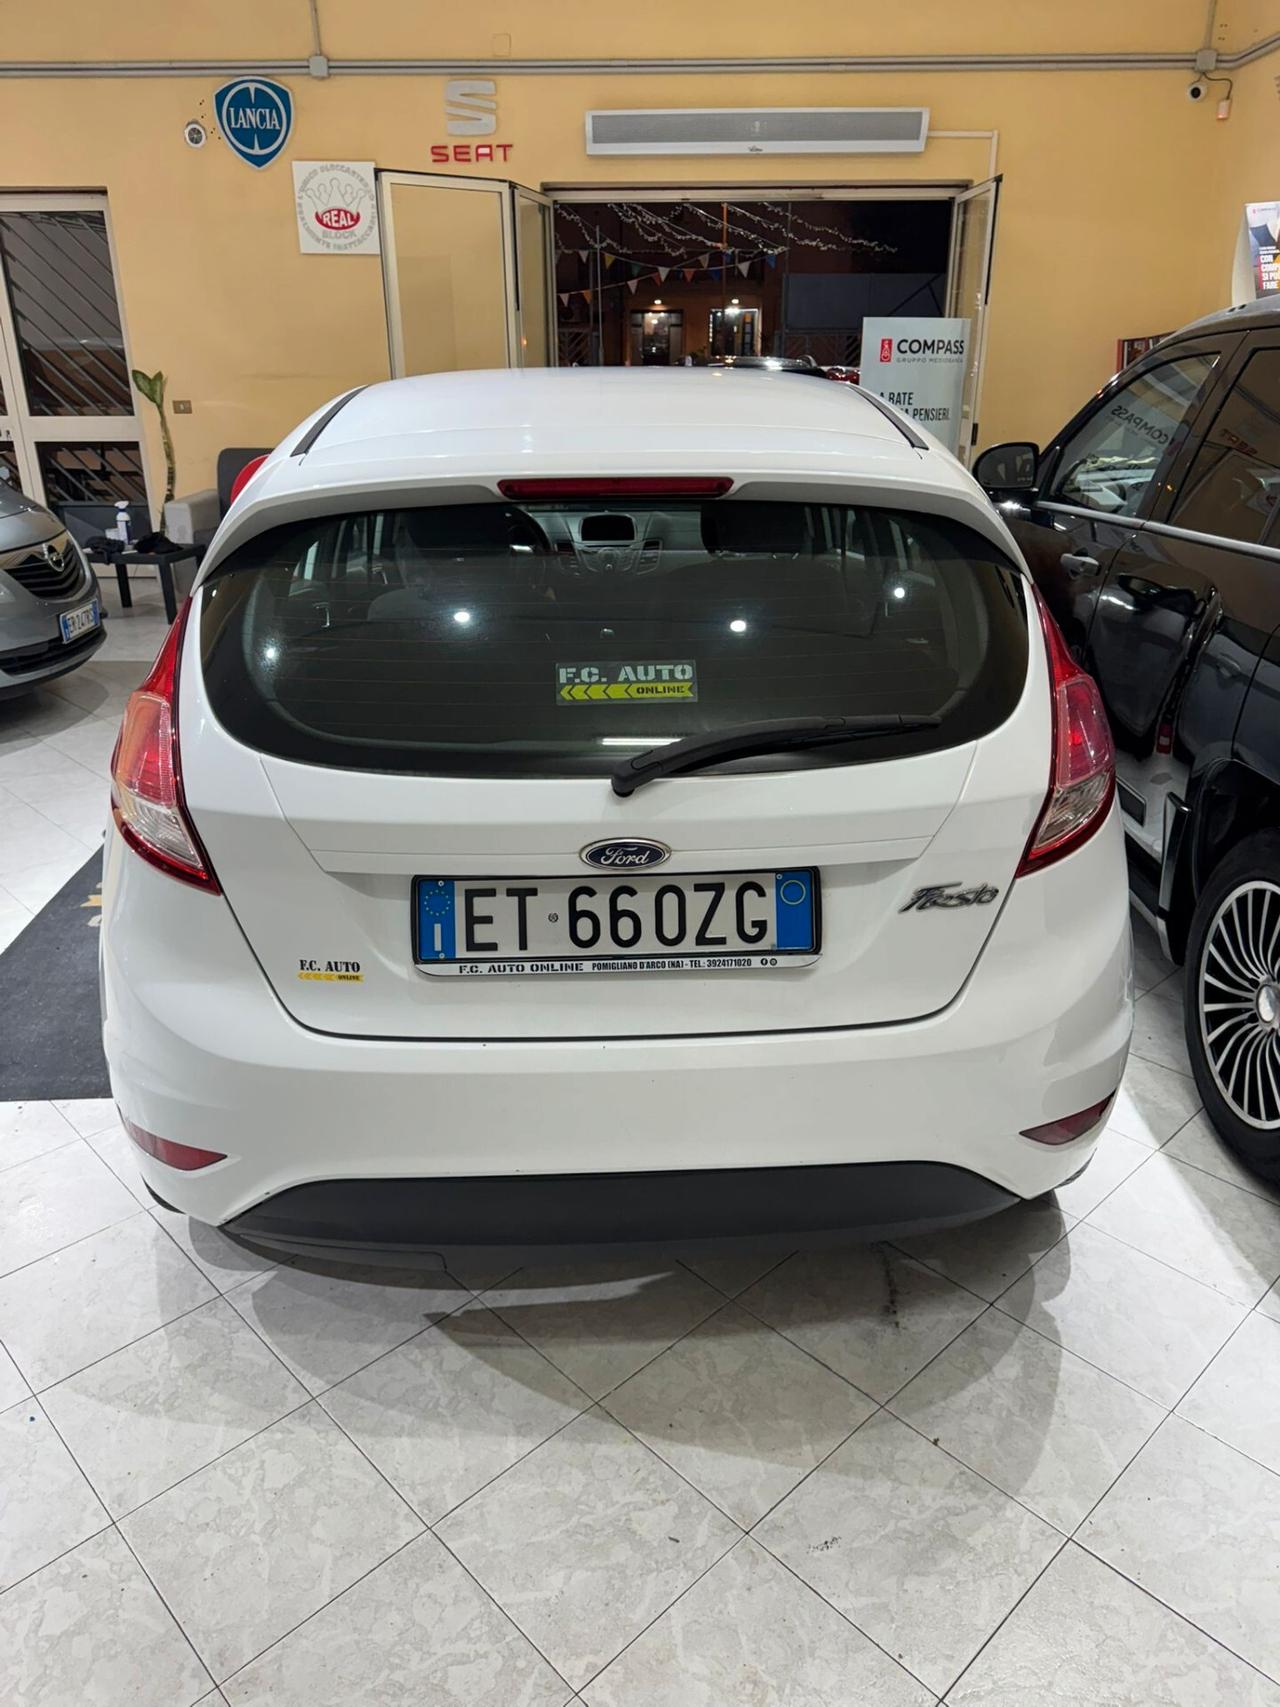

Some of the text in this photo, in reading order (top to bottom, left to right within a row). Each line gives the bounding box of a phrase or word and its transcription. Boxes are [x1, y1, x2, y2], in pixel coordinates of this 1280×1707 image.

[229, 107, 280, 129] LANCIA
[431, 144, 513, 163] SEAT
[322, 209, 355, 228] REAL
[322, 231, 357, 240] BLOCK
[897, 339, 965, 355] COMPASS
[888, 391, 914, 406] RATE
[559, 664, 693, 684] F.C. AUTO
[636, 685, 685, 695] ONLINE
[600, 846, 651, 865] Ford
[464, 887, 539, 952] ET
[568, 881, 768, 950] 660ZG
[299, 960, 361, 973] F.C. AUTO
[459, 964, 483, 974] F.C.
[488, 964, 525, 973] AUTO
[530, 962, 584, 973] ONLINE
[592, 961, 638, 971] POMIGLIANO
[639, 961, 666, 970] D'ARCO
[668, 960, 684, 969] (NA)
[707, 958, 752, 968] 3924171020
